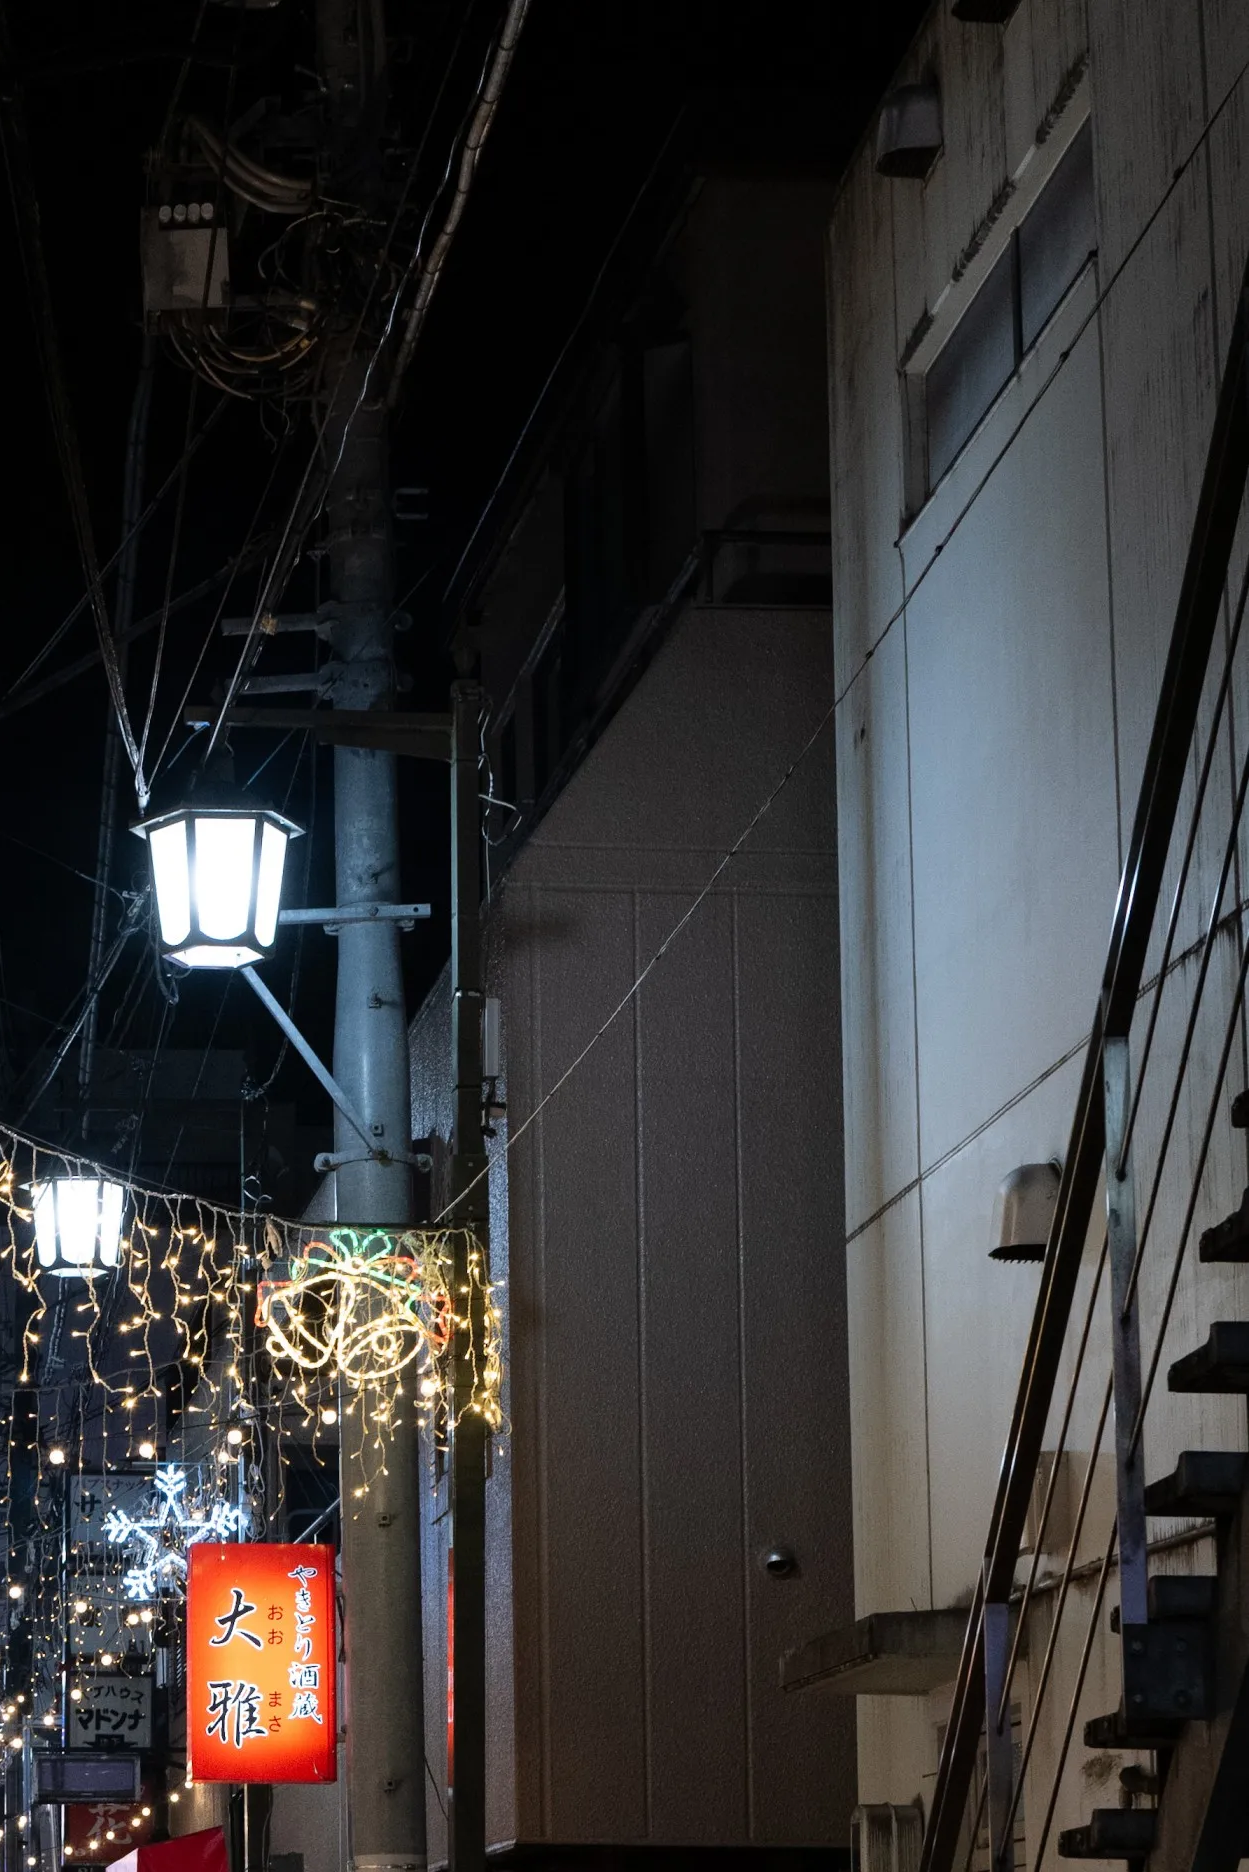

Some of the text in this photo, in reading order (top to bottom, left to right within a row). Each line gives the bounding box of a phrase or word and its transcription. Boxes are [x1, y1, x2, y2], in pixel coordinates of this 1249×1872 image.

[267, 1604, 284, 1645] おお
[288, 1565, 323, 1724] やきとり酒蔵
[207, 1589, 268, 1748] 大雅
[75, 1708, 146, 1731] マドンナ
[268, 1690, 283, 1733] まさ
